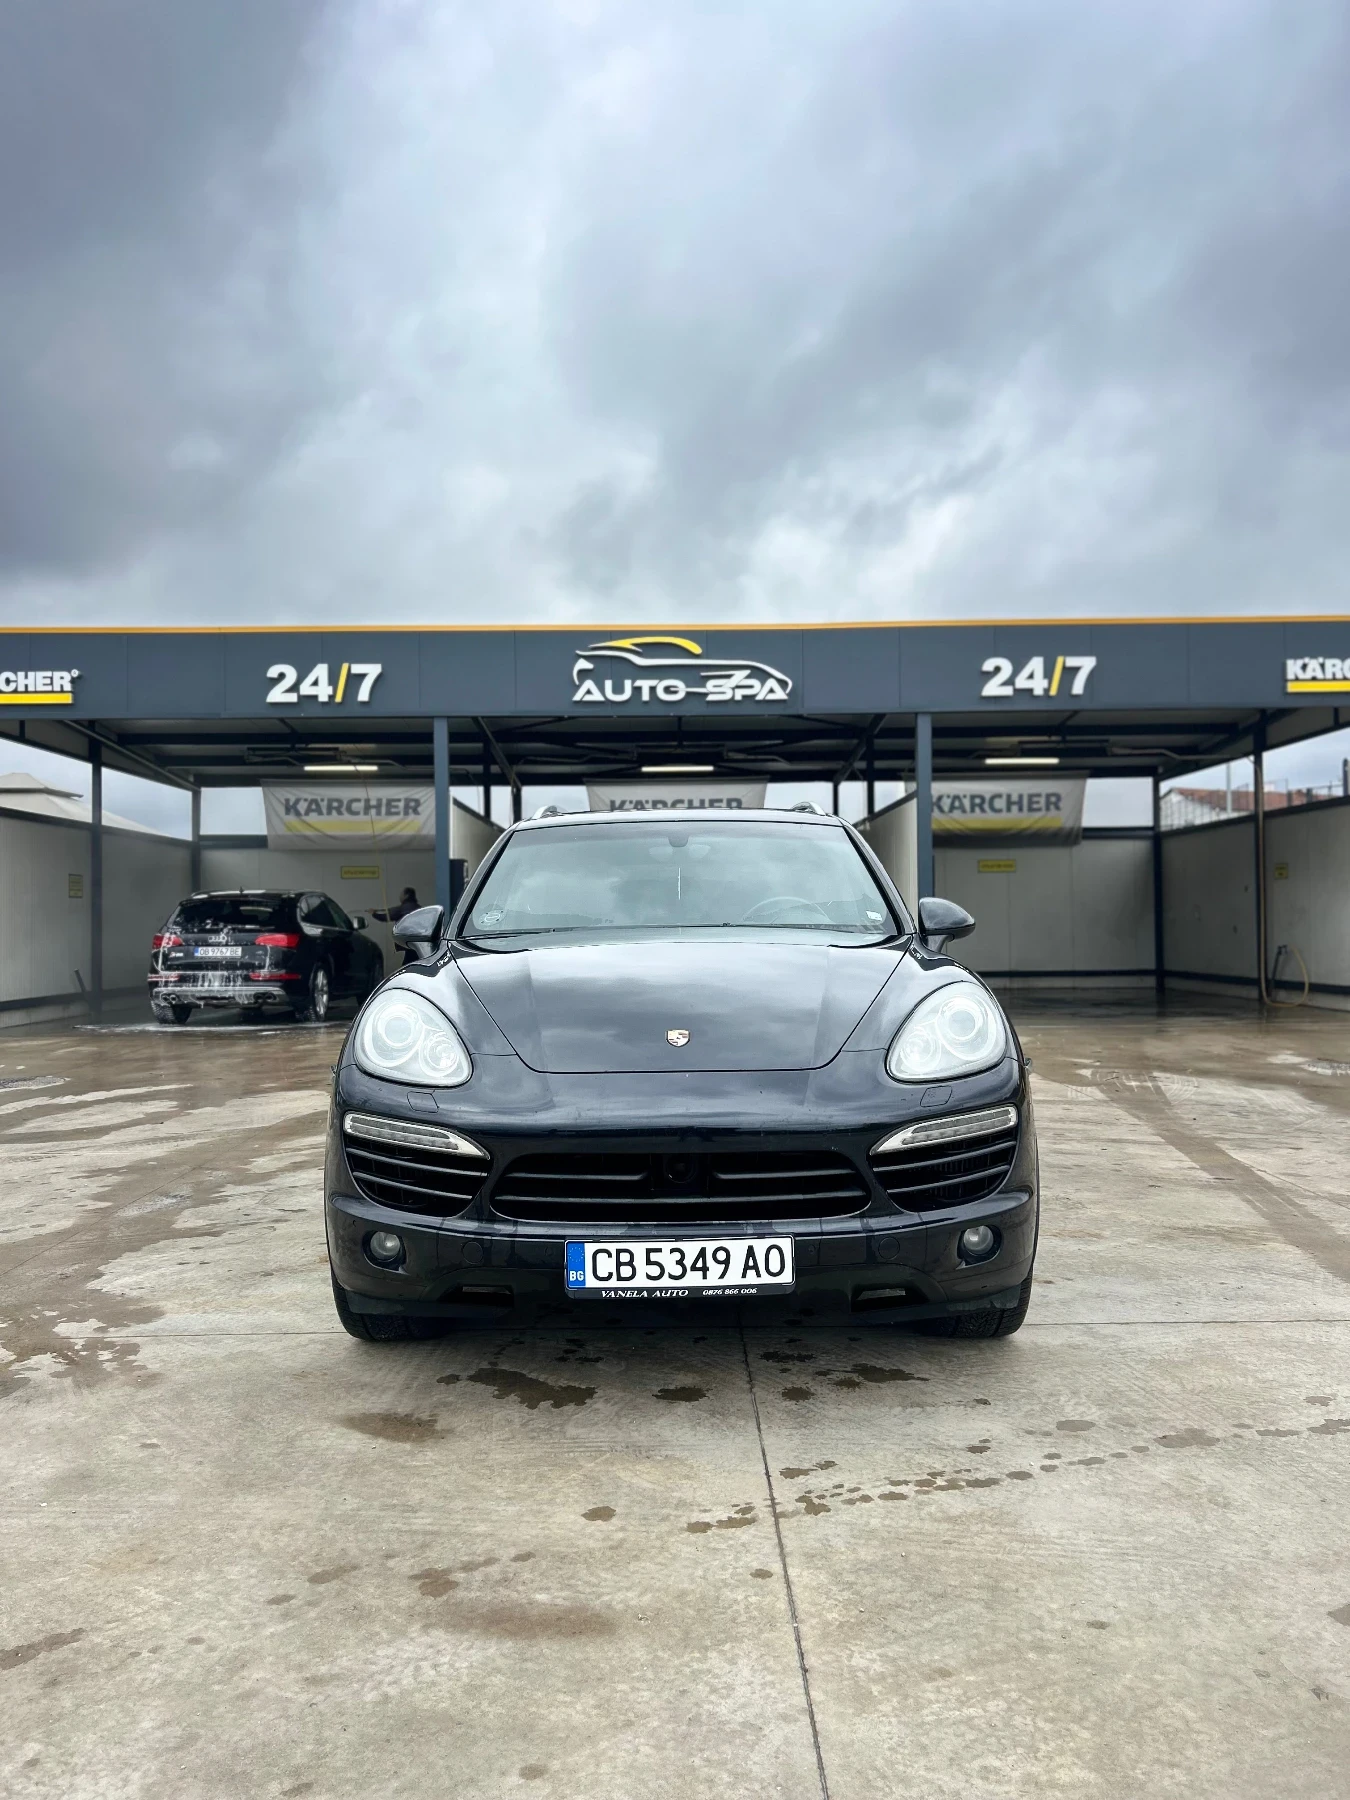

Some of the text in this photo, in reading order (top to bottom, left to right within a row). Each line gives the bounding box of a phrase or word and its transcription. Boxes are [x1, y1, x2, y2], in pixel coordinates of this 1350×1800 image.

[265, 662, 383, 703] 24/7
[980, 655, 1097, 697] 24/7
[572, 676, 789, 702] AUTO SPA
[284, 797, 421, 816] KÄRCHER
[931, 792, 1063, 814] KÄRCHER
[210, 947, 229, 956] 9767
[592, 1243, 786, 1282] CB 5349 AO
[569, 1270, 585, 1282] BG
[601, 1290, 648, 1298] VANELA
[651, 1289, 689, 1298] AUTO
[702, 1288, 723, 1296] 0876
[724, 1287, 739, 1295] 866
